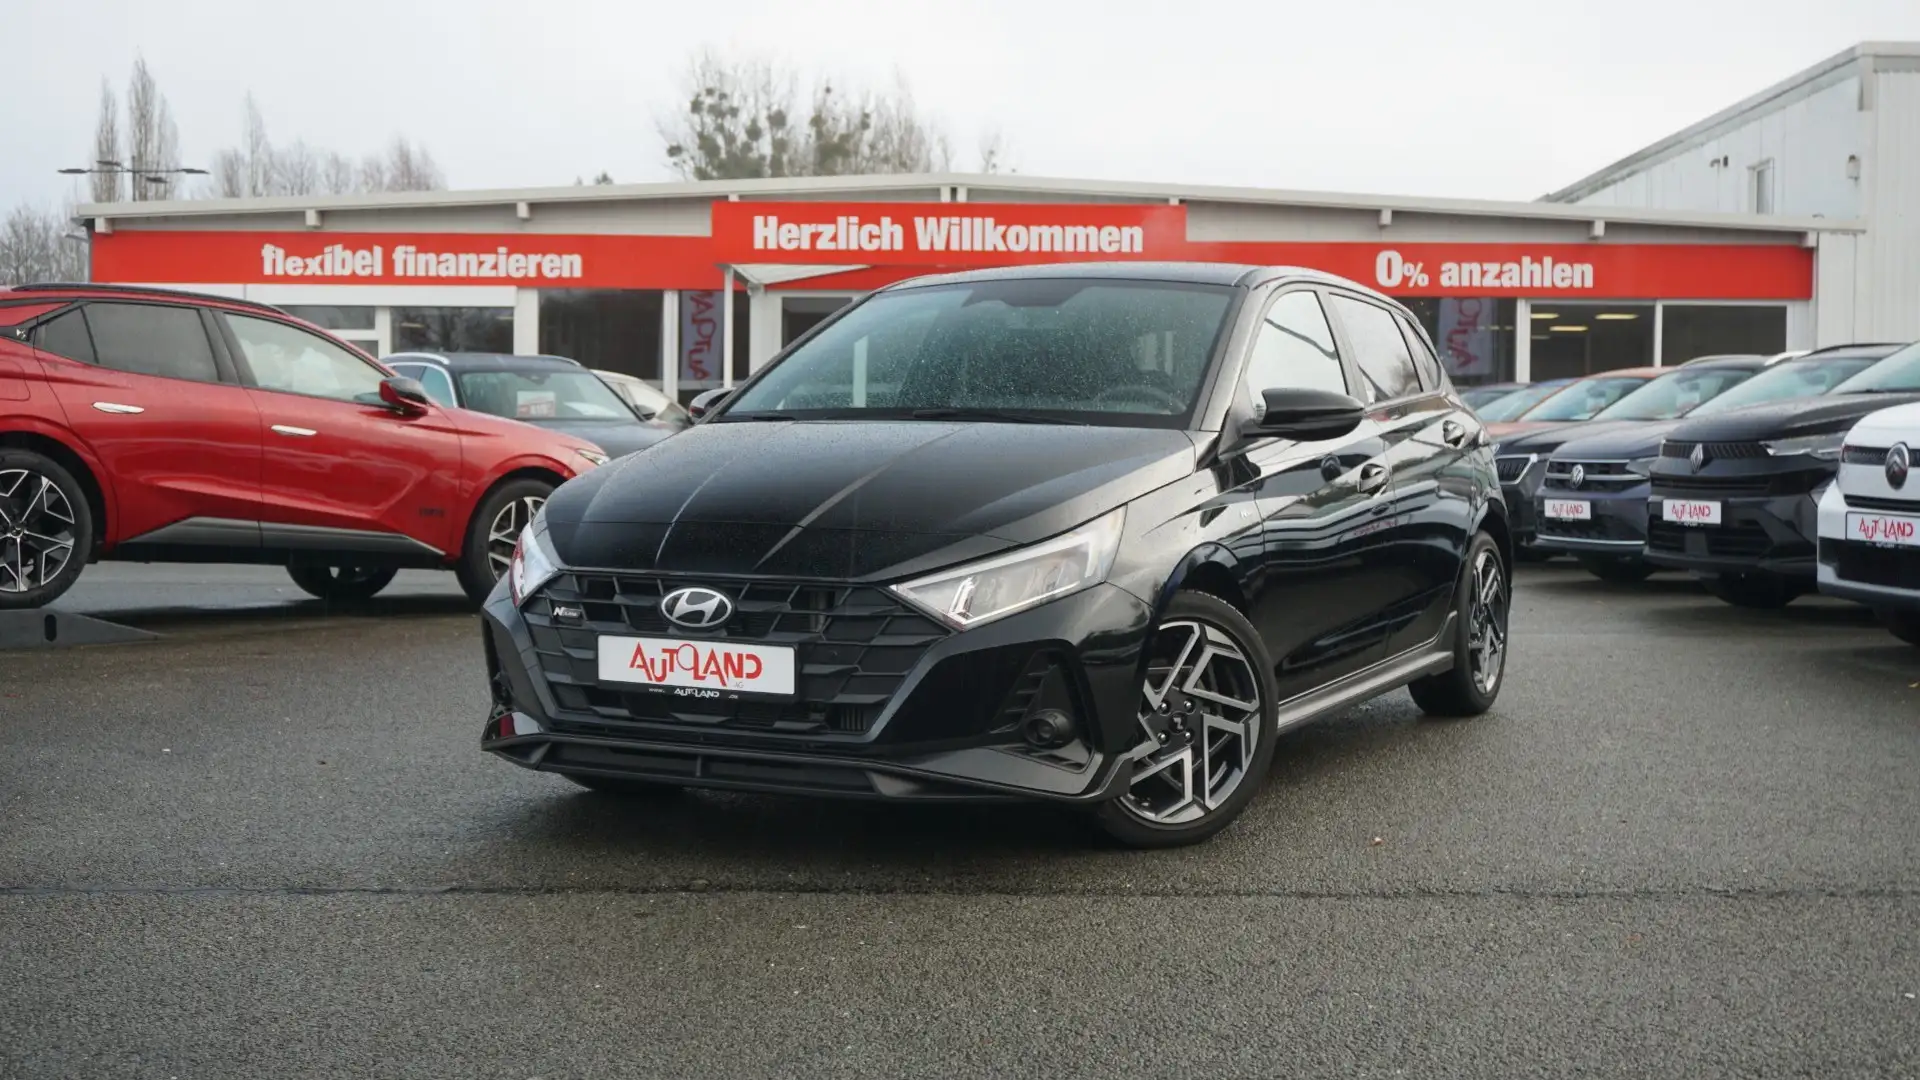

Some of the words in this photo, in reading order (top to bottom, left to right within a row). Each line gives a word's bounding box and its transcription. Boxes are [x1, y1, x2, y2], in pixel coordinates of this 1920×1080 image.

[753, 216, 904, 251] Herzlich
[913, 217, 1144, 253] Willkommen
[261, 244, 383, 277] flexibel
[391, 246, 582, 279] finanzieren
[1376, 250, 1429, 288] 0%
[1439, 256, 1594, 289] anzahlen
[1858, 515, 1914, 542] AUTOLAND
[629, 641, 763, 687] AUTOLAND
